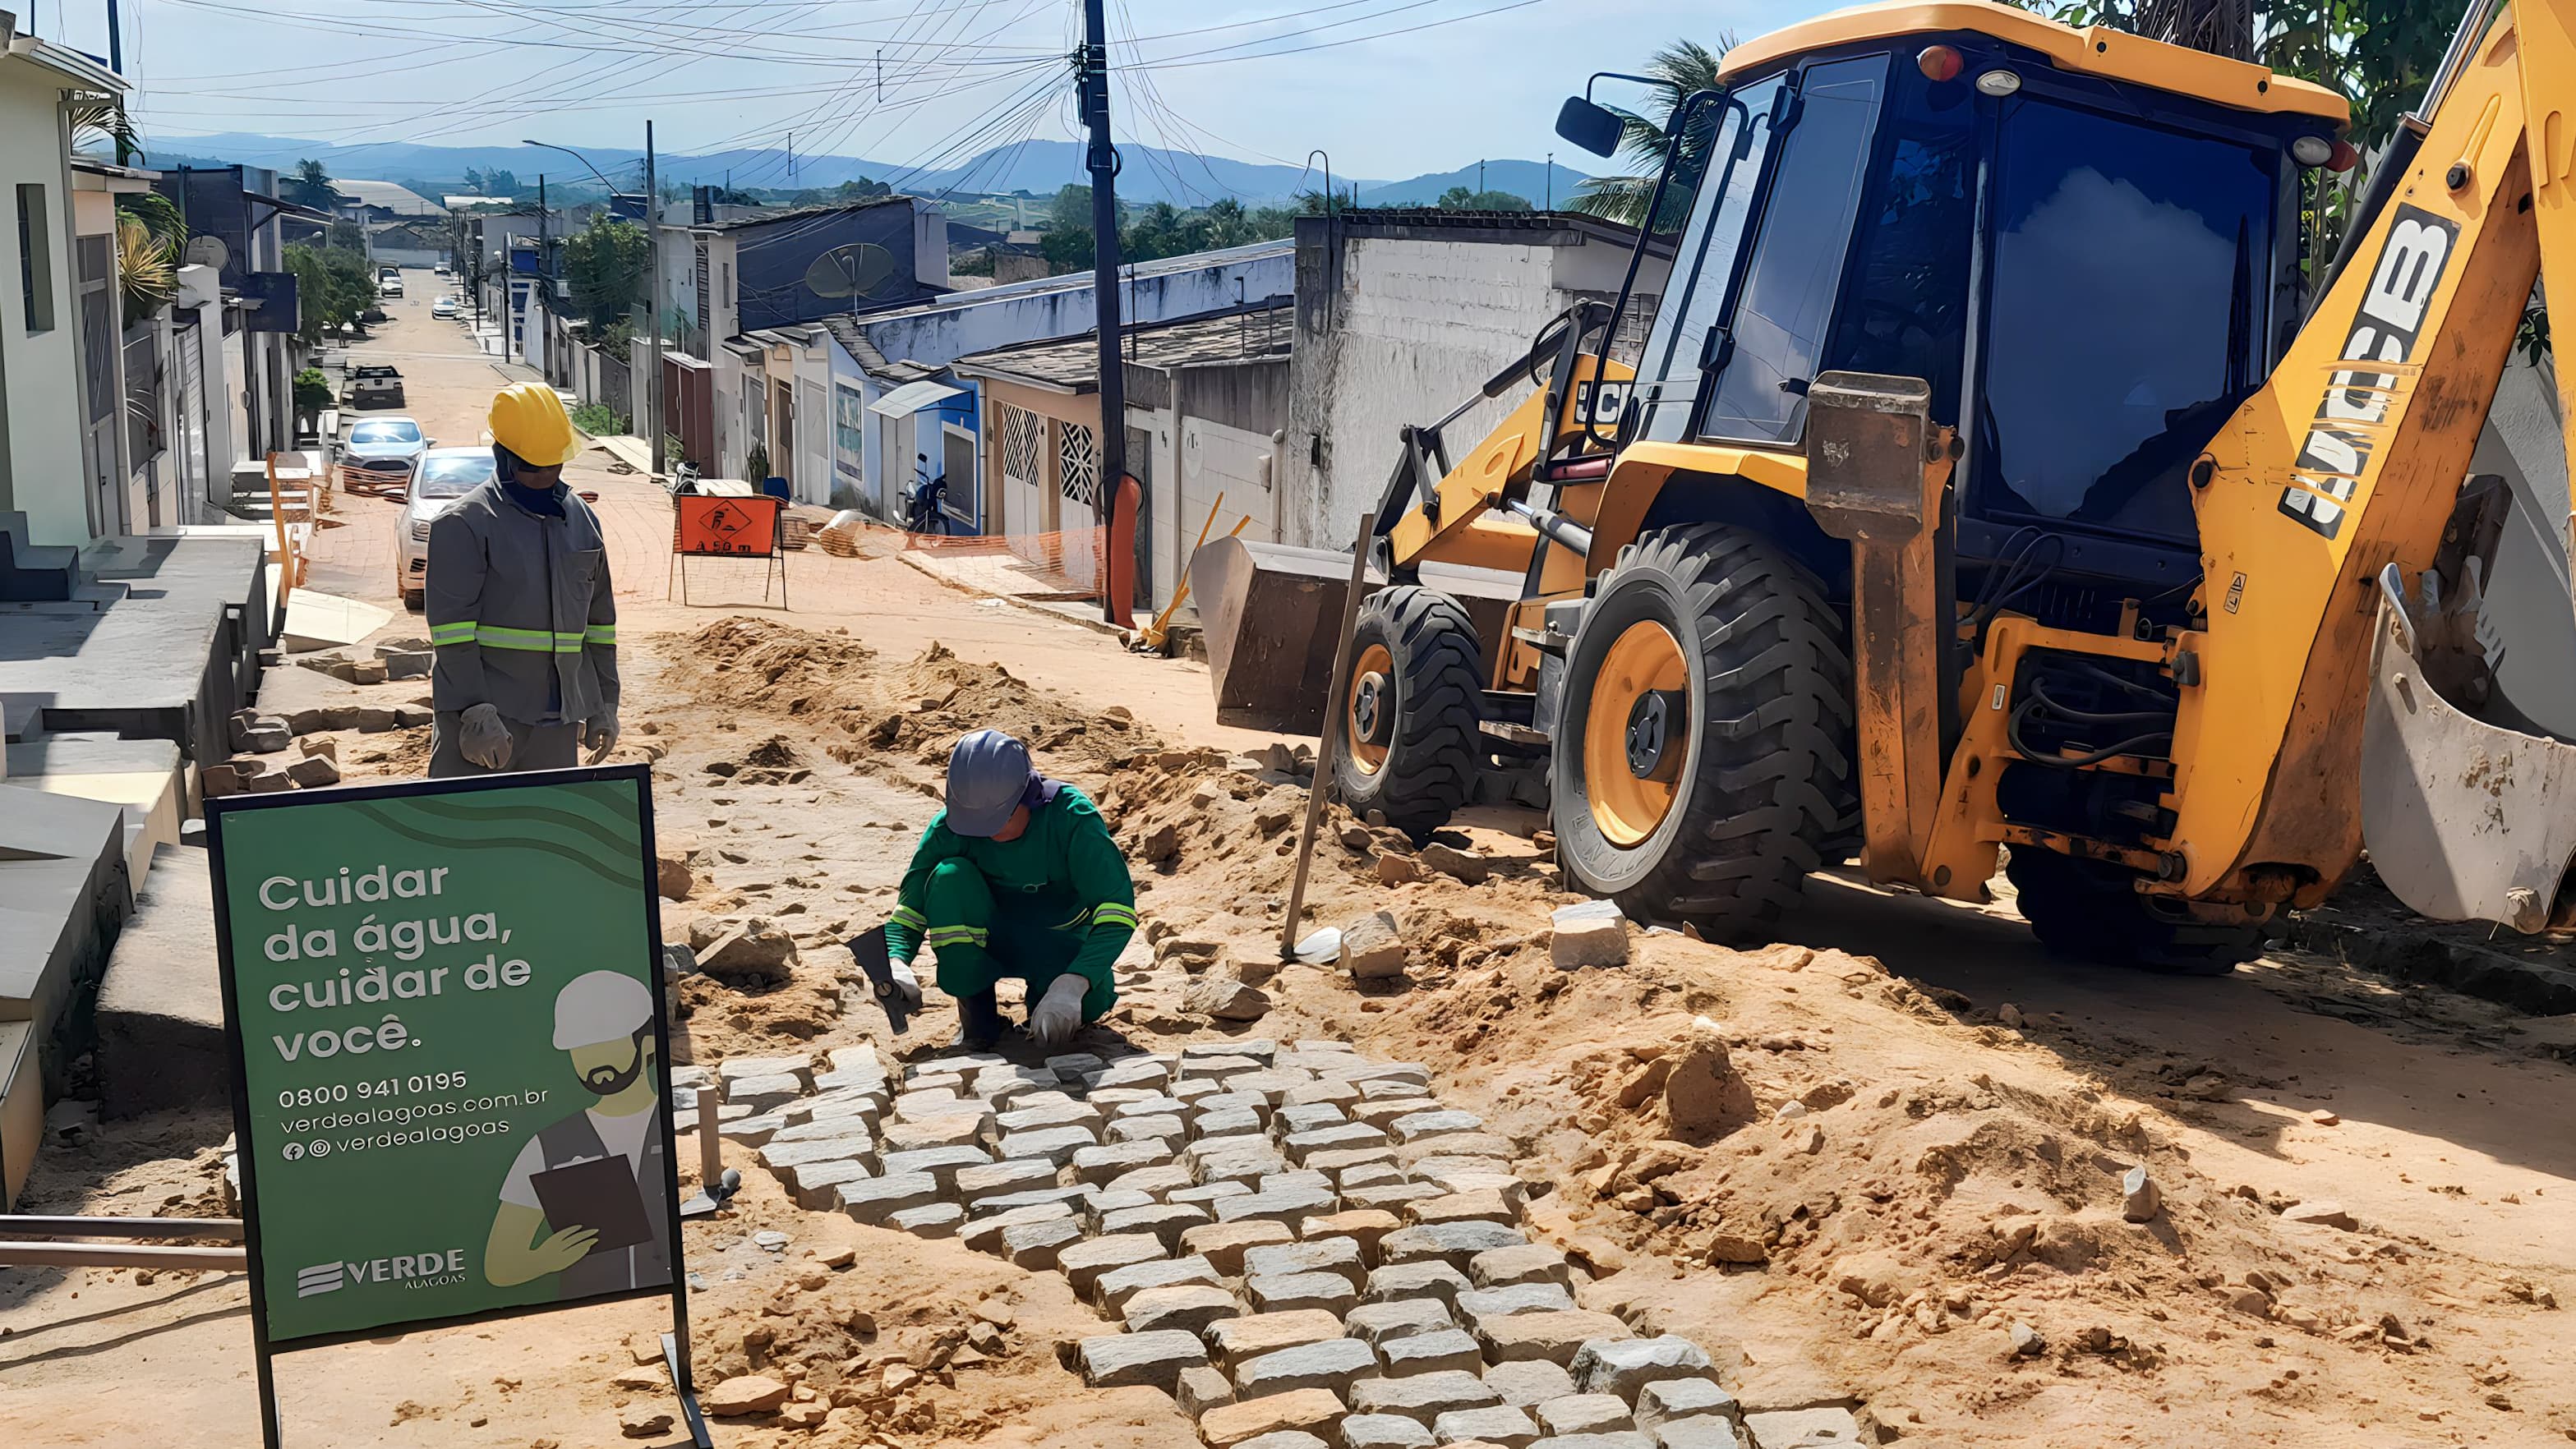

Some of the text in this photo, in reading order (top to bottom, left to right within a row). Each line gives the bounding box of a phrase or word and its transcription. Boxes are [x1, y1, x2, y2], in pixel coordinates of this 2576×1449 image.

[2284, 218, 2449, 524] JCB
[259, 864, 449, 911] Cuidar
[264, 912, 512, 962] da água,
[269, 953, 532, 1012] cuidar de
[272, 1013, 422, 1061] você.
[279, 1070, 467, 1108] 0800 941 0195
[280, 1087, 548, 1134] verdealagoas.com.br
[336, 1120, 509, 1152] verdealagoas
[346, 1249, 466, 1284] VERDE
[404, 1273, 466, 1290] ALAGOAS
